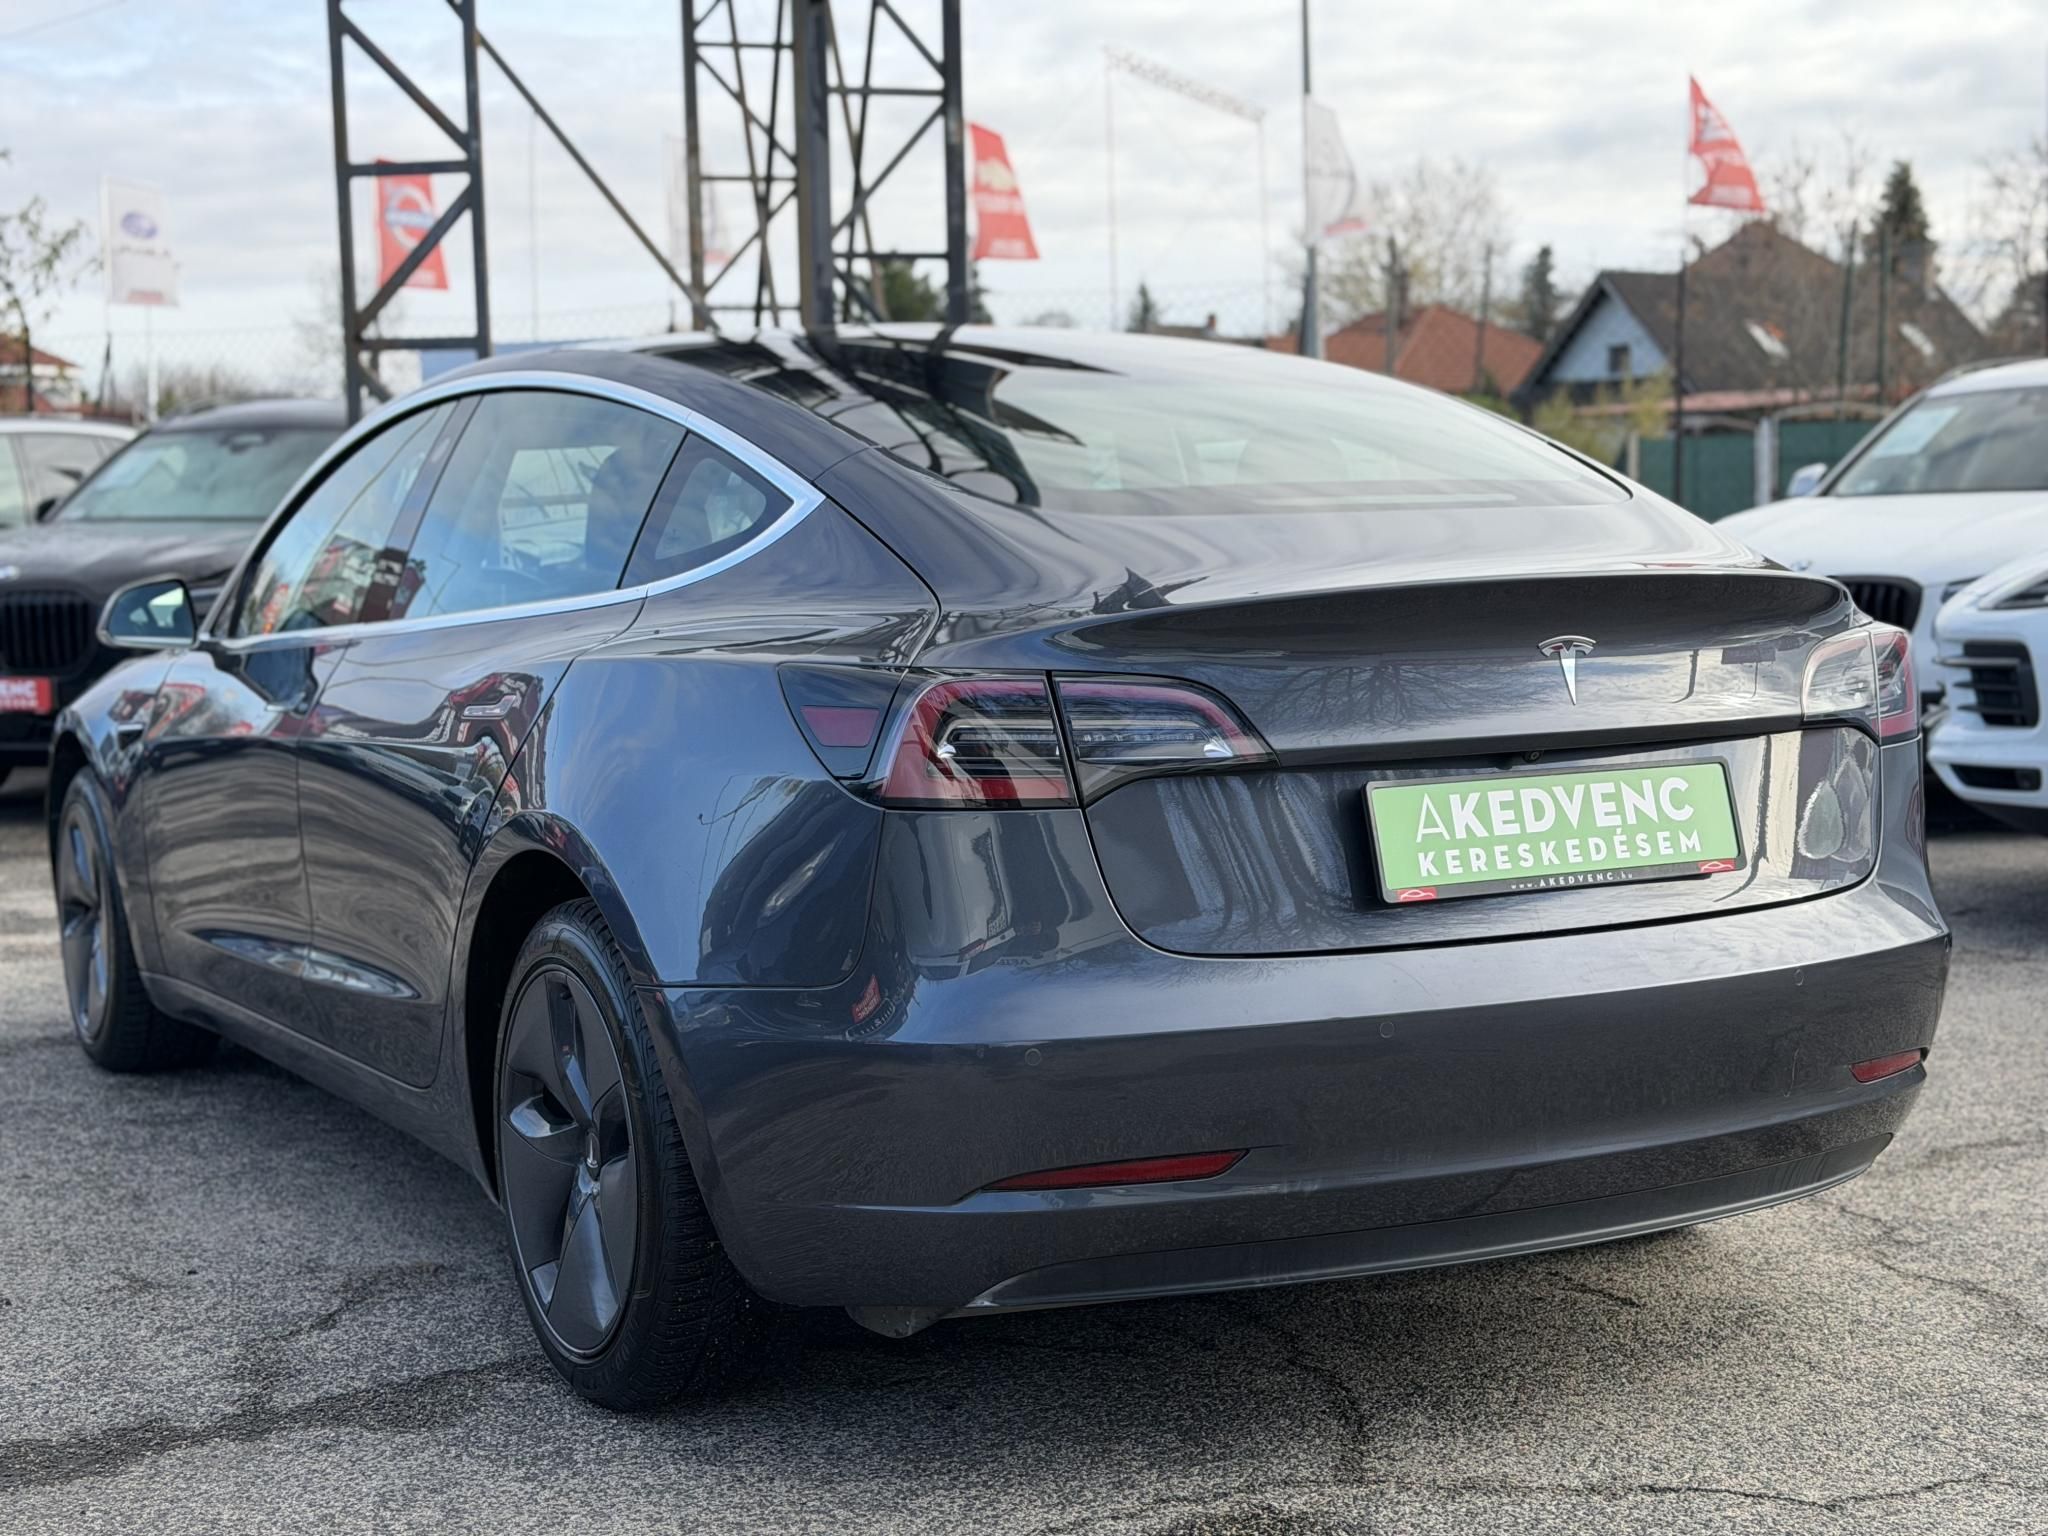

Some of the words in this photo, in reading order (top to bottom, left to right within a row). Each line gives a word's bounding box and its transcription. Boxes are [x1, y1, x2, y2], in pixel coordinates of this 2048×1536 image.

[1416, 777, 1694, 842] AKEDVENC
[1419, 829, 1701, 877] KERESKEDÉSEM
[1511, 872, 1633, 889] www.AKEDVENC.hu
